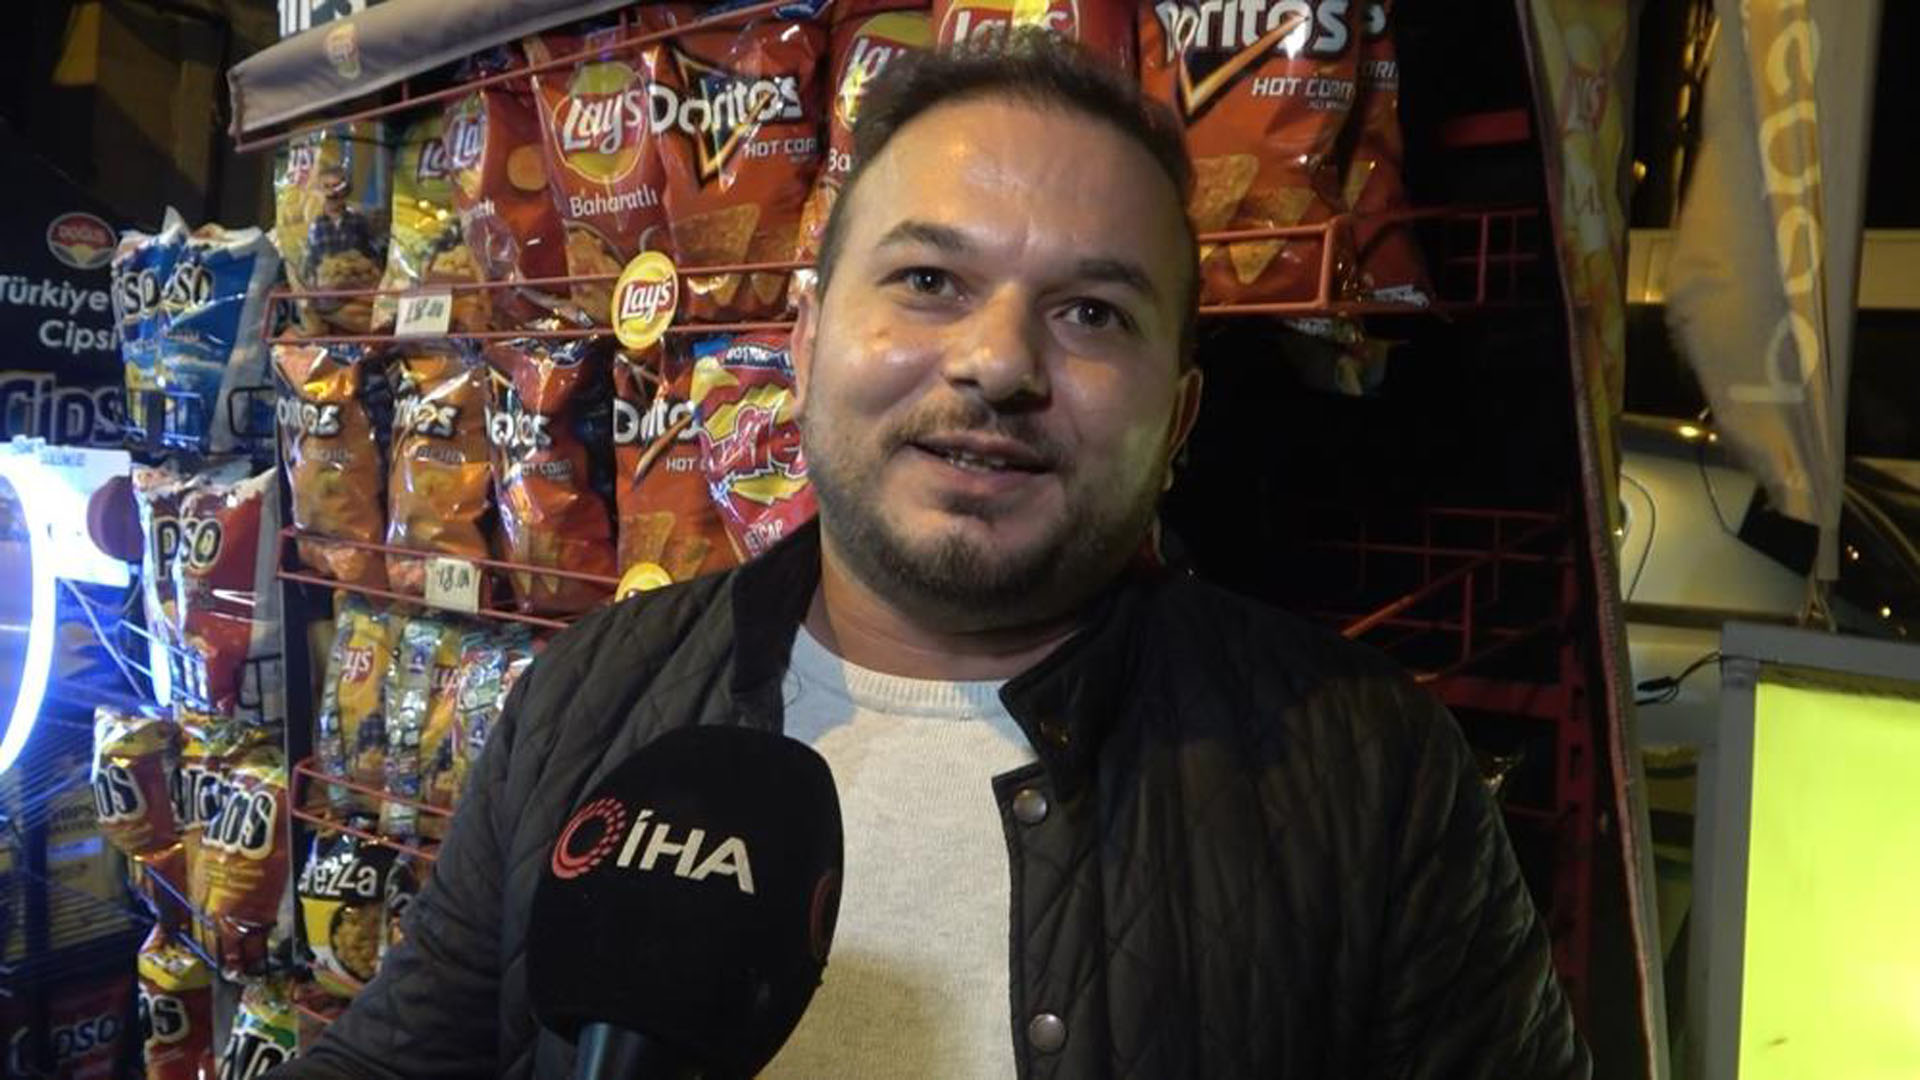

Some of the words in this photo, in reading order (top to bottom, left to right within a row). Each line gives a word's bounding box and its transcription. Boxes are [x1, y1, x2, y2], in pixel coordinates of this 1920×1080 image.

[1251, 77, 1301, 97] HOT
[648, 76, 803, 137] Doritos
[743, 139, 778, 158] HOT
[569, 184, 658, 218] Baharatlı
[619, 274, 673, 323] Lay's
[666, 456, 697, 472] HOT
[616, 808, 755, 895] İHA
